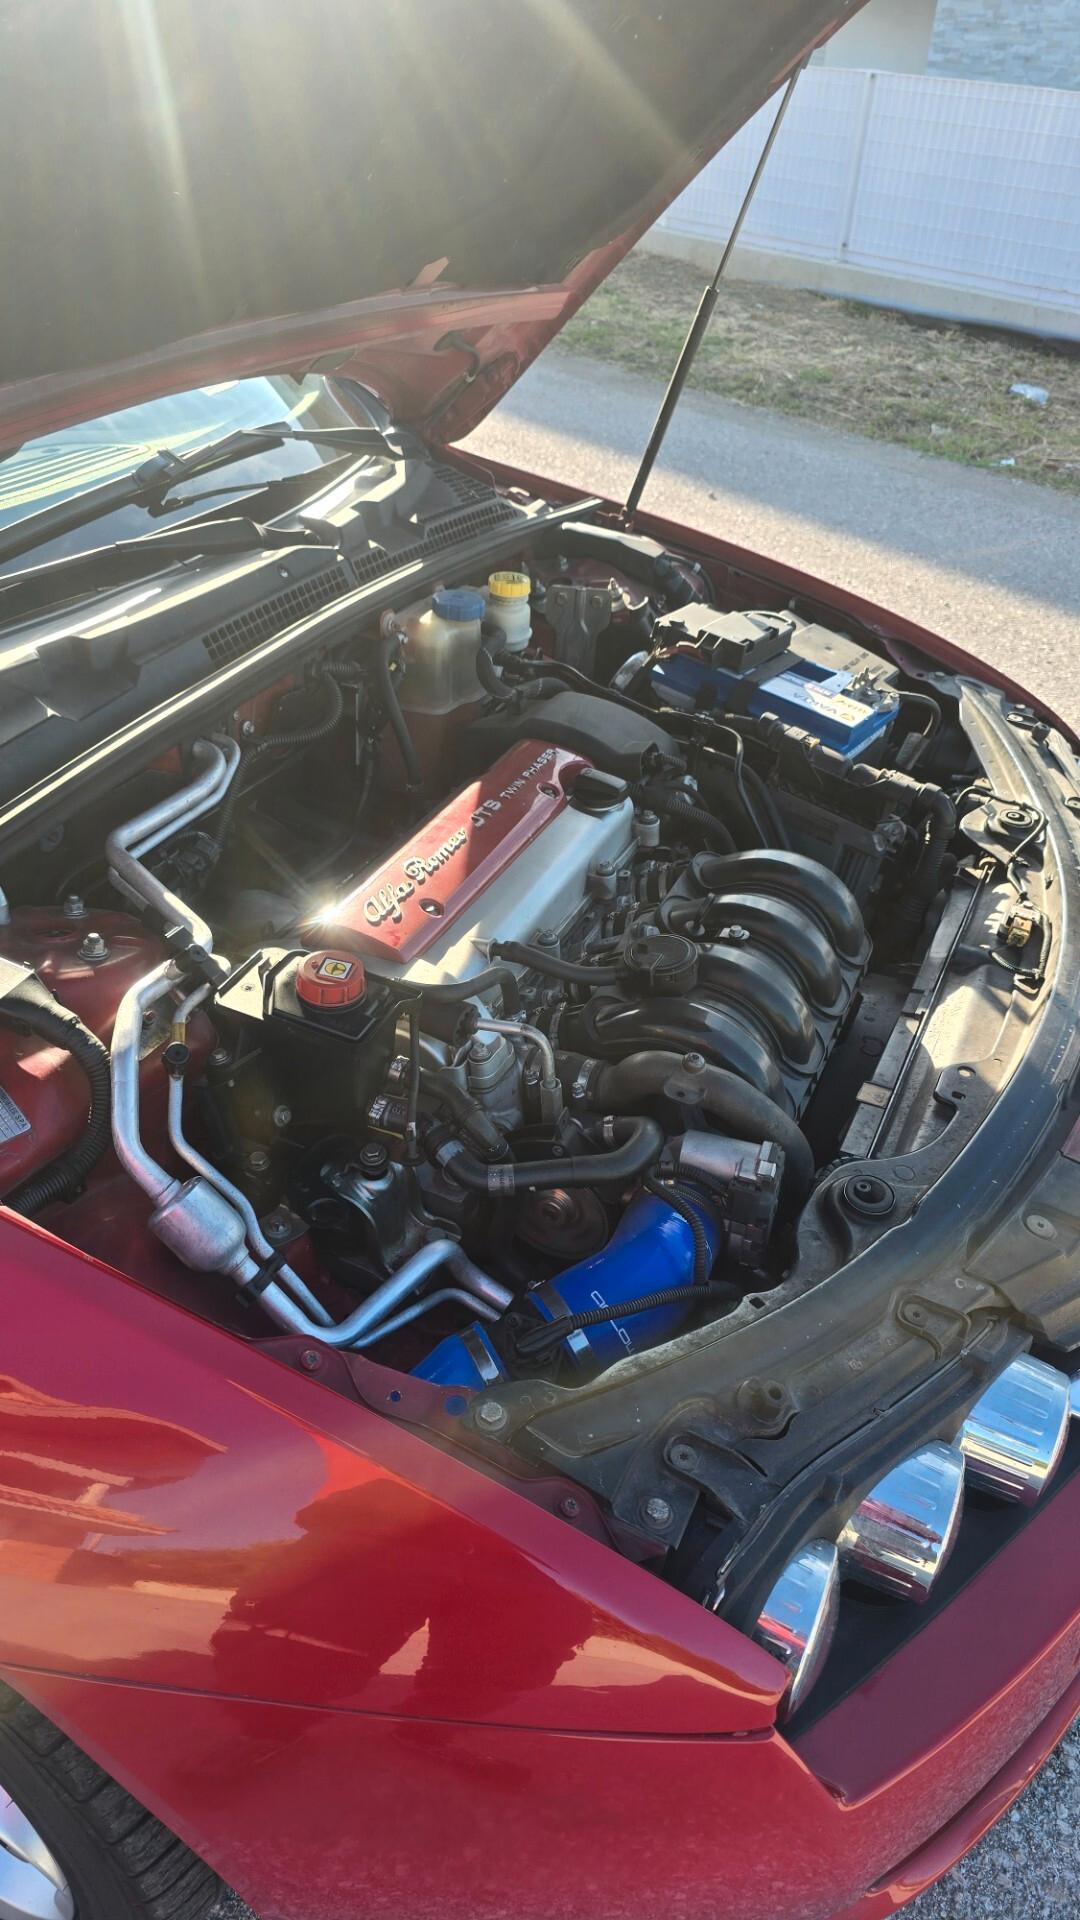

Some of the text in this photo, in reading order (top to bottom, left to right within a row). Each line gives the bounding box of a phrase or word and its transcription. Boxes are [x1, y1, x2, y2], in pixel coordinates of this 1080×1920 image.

[364, 881, 414, 923] Alfa
[404, 828, 468, 884] Romeo
[471, 800, 502, 827] JTS
[500, 778, 526, 799] TWIN
